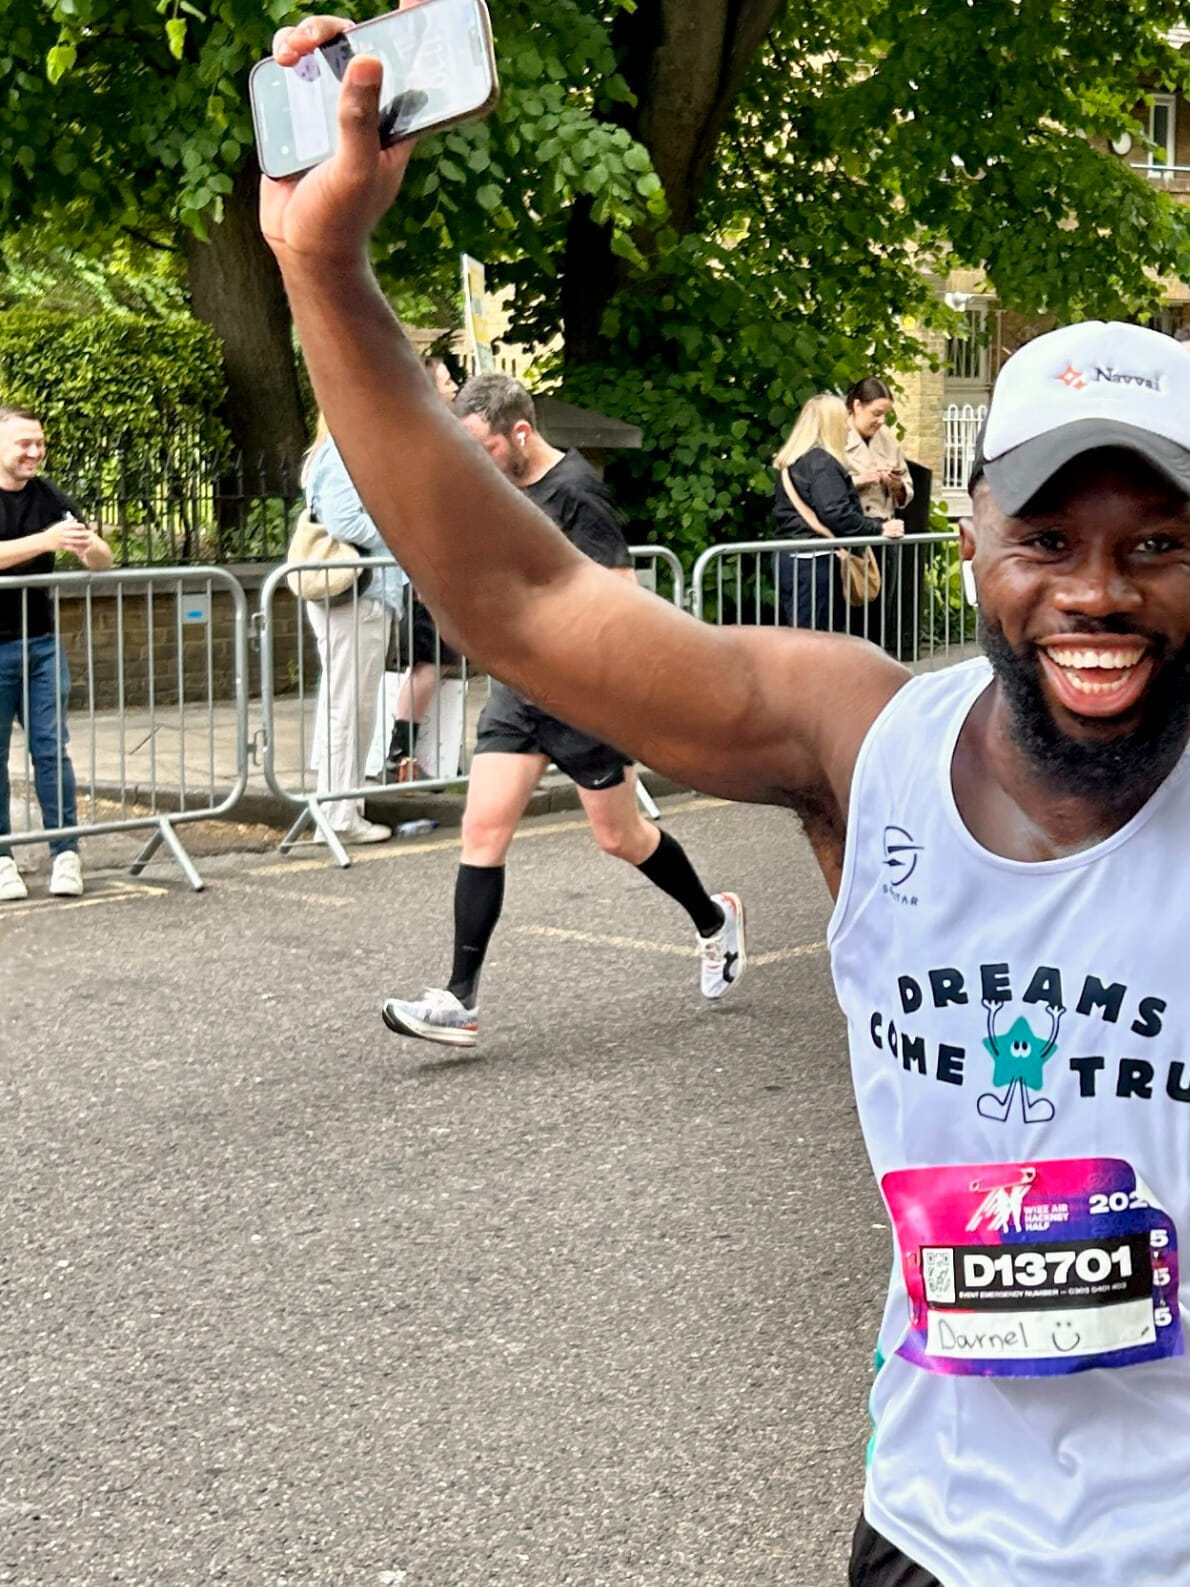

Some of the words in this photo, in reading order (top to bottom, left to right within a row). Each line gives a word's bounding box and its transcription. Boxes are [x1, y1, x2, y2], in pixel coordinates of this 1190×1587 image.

[897, 962, 1167, 1038] DREAMS
[870, 1011, 966, 1086] COME
[1024, 1212, 1069, 1223] HACKNEY
[1051, 1203, 1069, 1213] AIR
[1088, 1190, 1149, 1215] 202
[963, 1245, 1133, 1287] D13701
[938, 1318, 1028, 1350] Darnel
